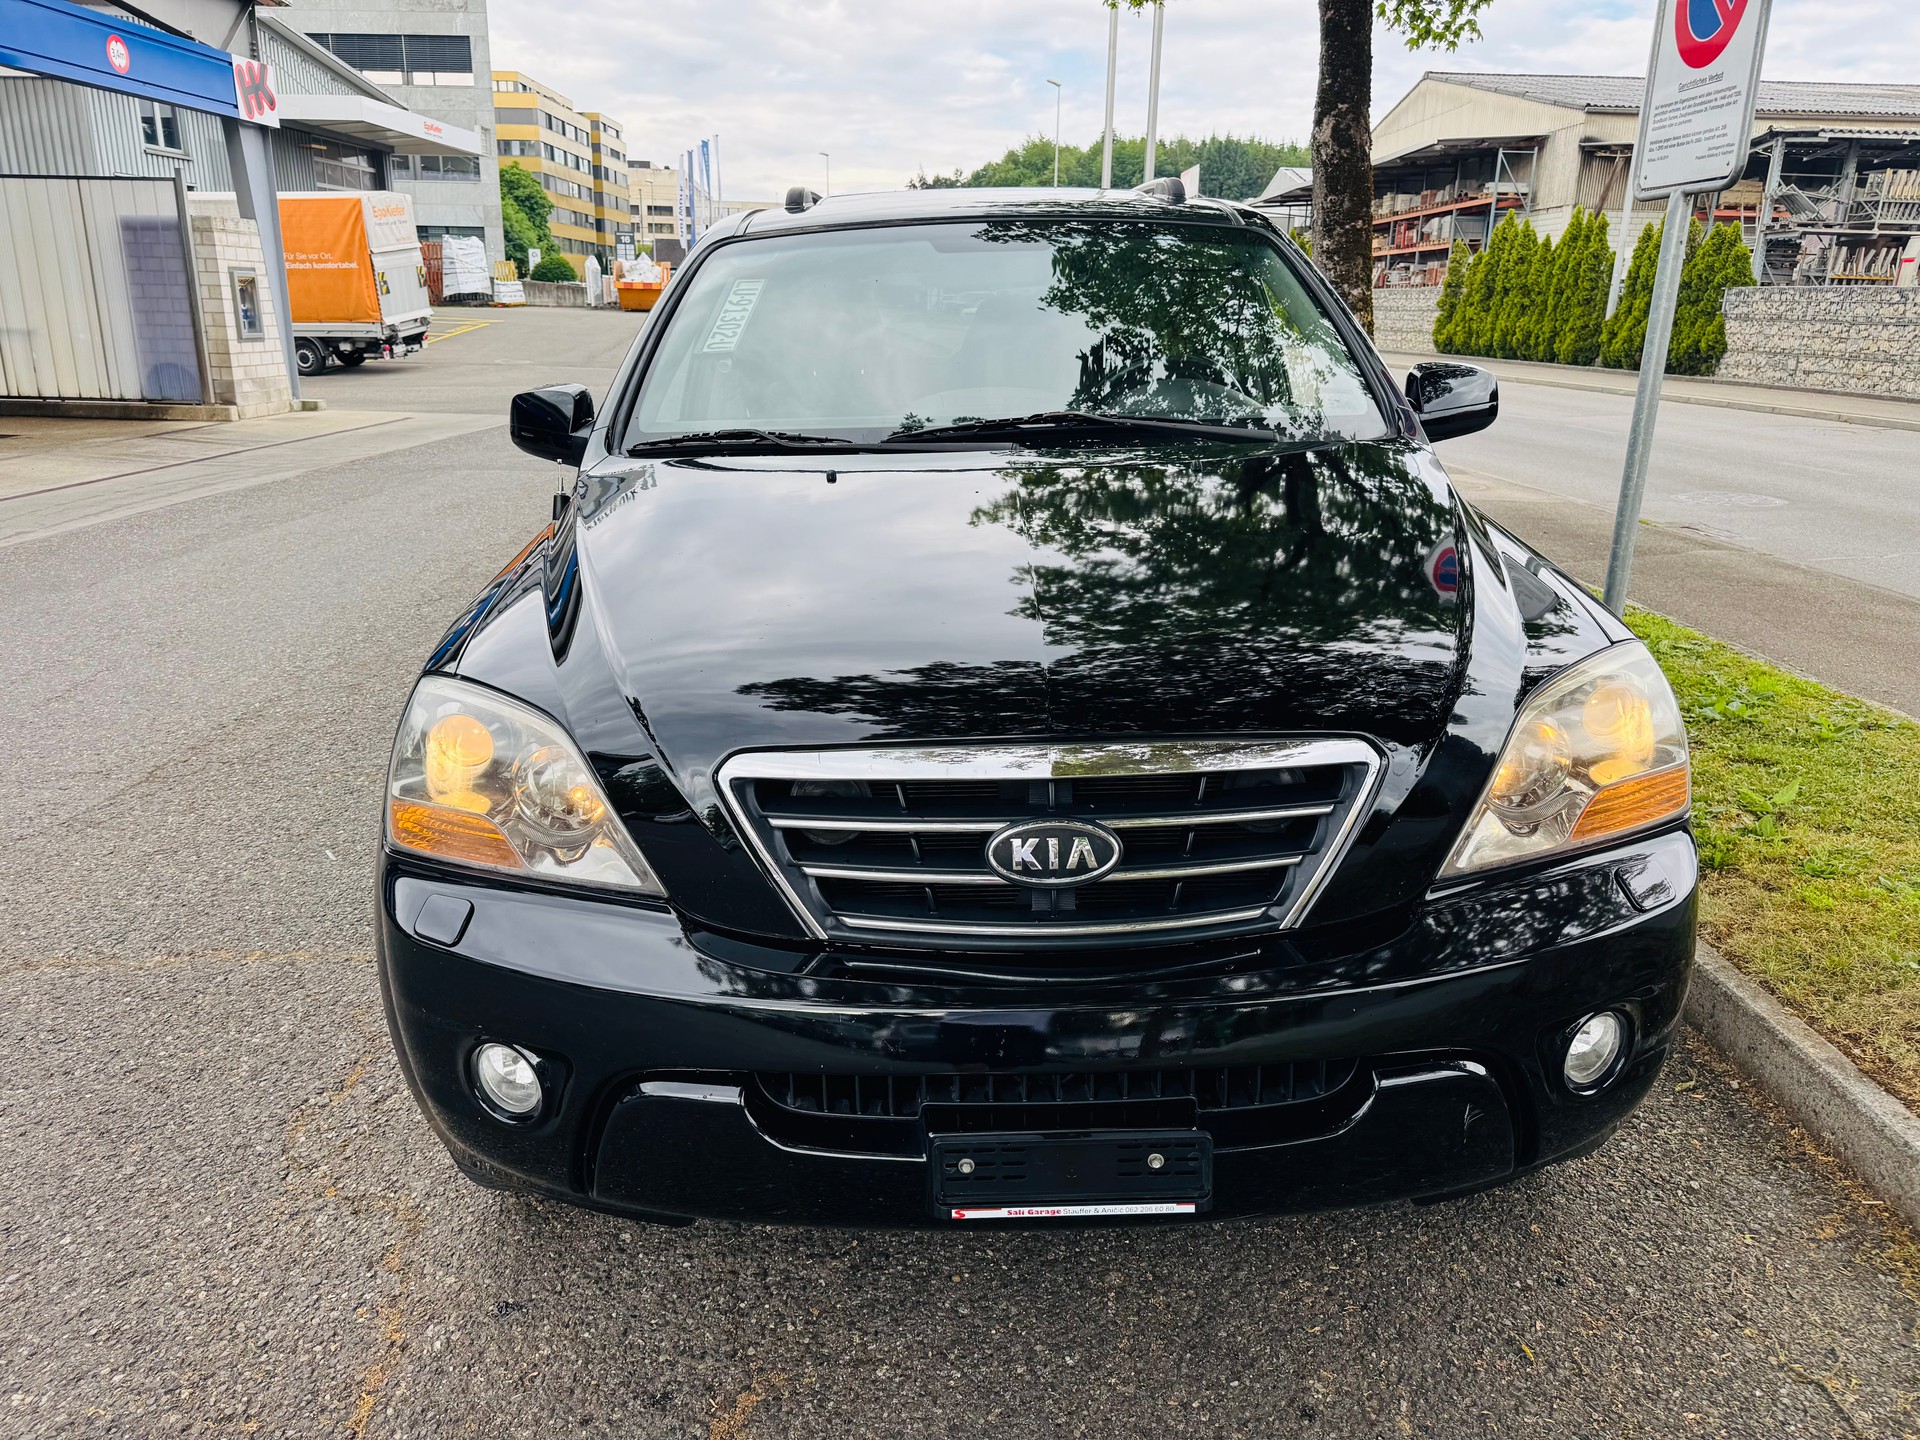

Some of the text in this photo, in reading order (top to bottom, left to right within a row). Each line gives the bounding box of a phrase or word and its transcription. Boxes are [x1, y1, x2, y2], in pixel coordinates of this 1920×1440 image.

[1708, 71, 1724, 82] Verbot
[371, 203, 405, 221] EgoKiefer
[620, 235, 632, 243] 16
[283, 251, 294, 261] Für
[296, 252, 307, 260] Sie
[320, 251, 334, 260] Ort.
[286, 260, 359, 270] Einfach komfortabel.
[1010, 836, 1098, 870] KIA
[1027, 1208, 1062, 1216] Garage
[1063, 1207, 1091, 1215] Stauffer
